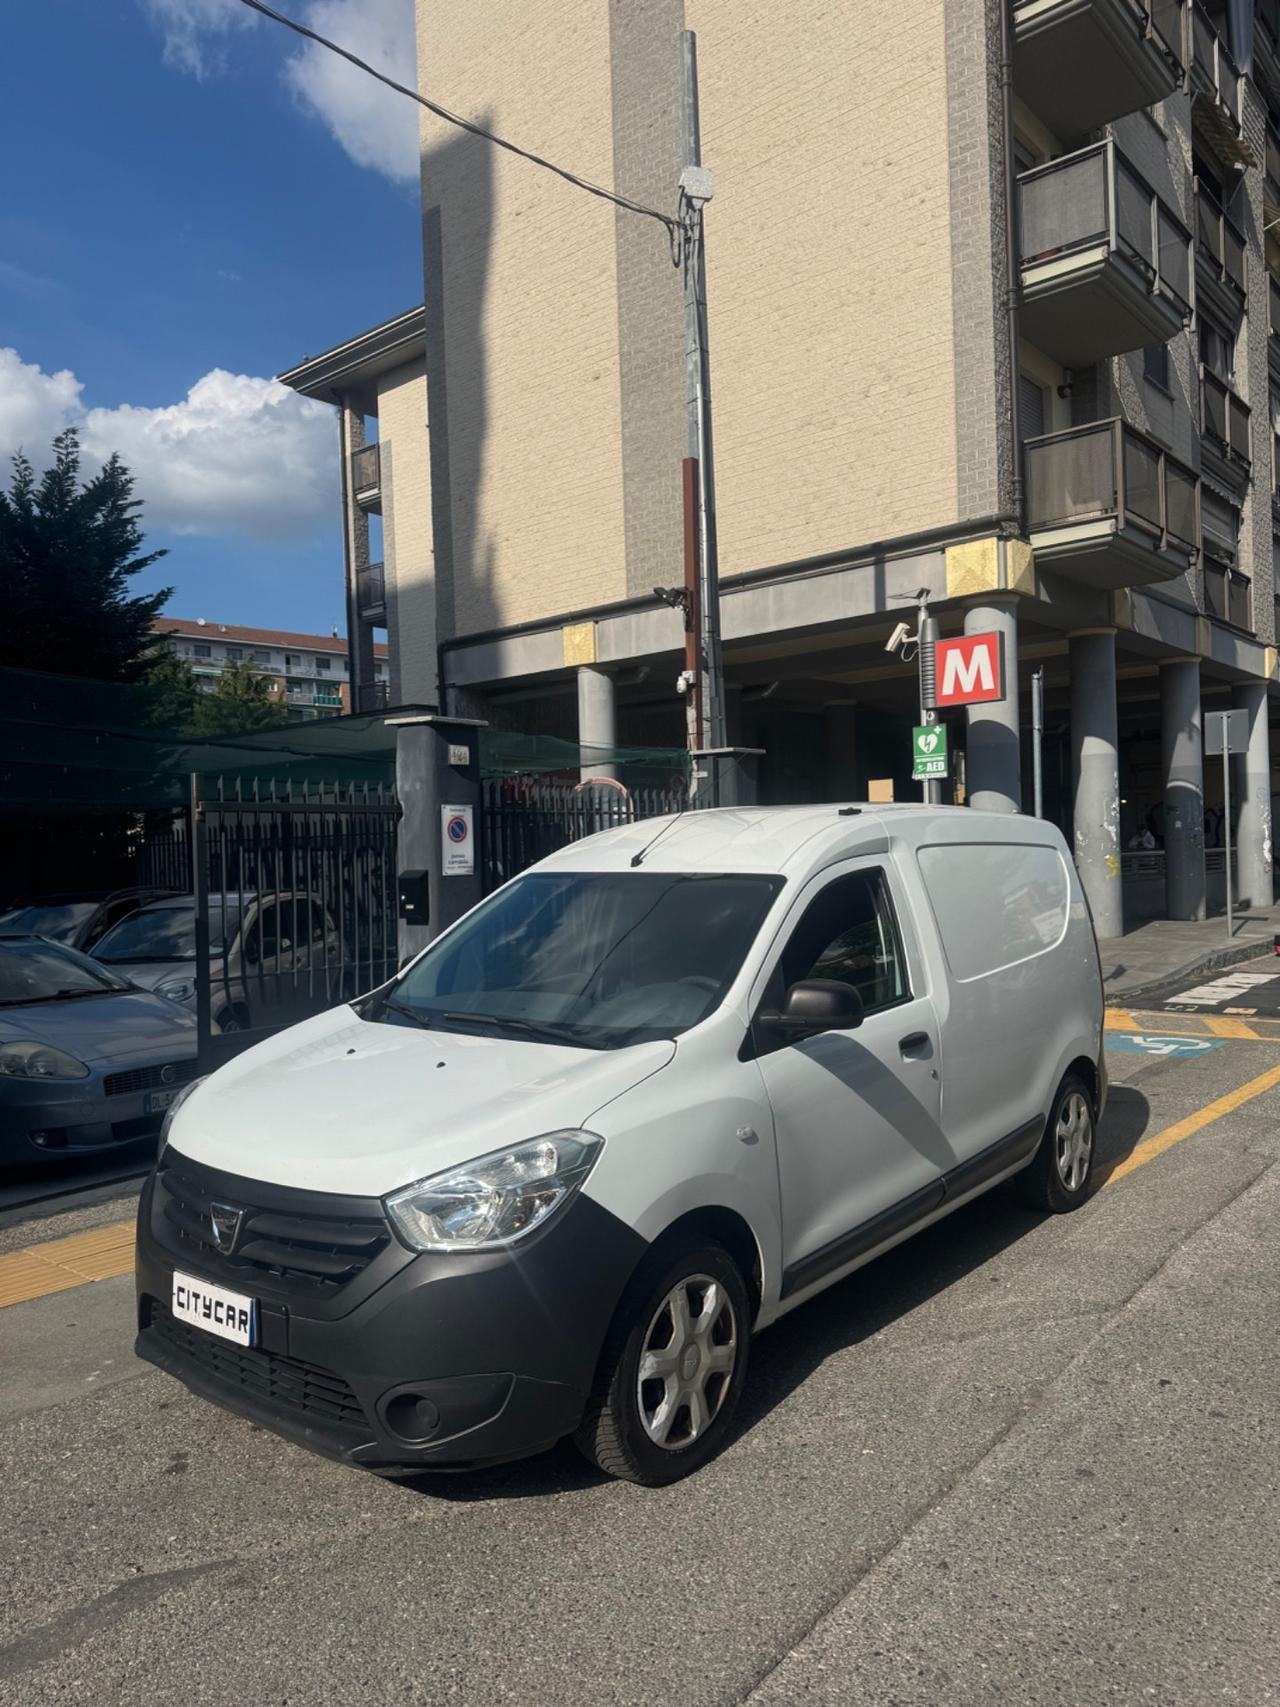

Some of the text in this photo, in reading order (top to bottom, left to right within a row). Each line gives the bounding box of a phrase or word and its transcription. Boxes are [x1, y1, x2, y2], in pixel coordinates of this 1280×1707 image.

[941, 644, 995, 696] M
[926, 761, 945, 772] AED
[176, 1285, 248, 1334] CITYCAR
